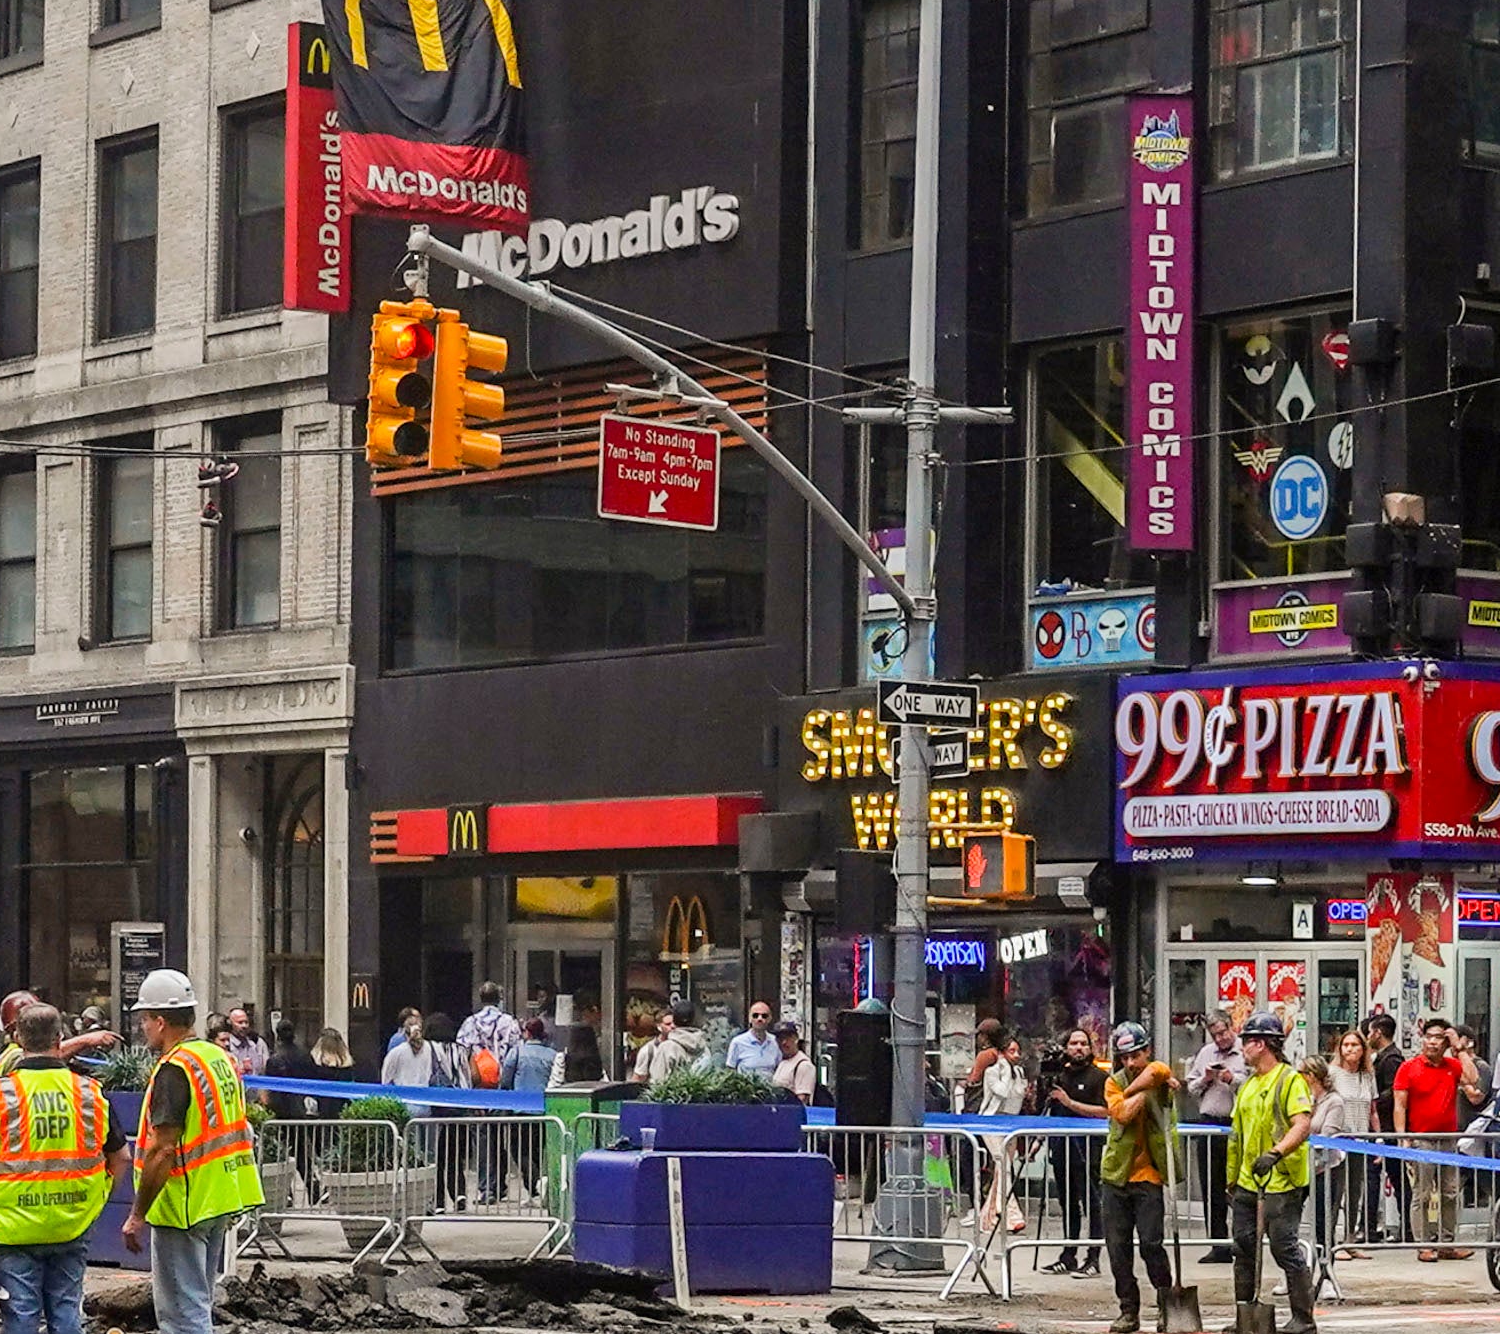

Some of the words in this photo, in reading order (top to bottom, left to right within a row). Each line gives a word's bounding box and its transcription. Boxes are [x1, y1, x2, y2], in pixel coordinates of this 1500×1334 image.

[316, 110, 342, 298] McDonald's
[367, 165, 528, 215] McDonald's
[456, 185, 740, 289] McDonald's
[1140, 182, 1184, 362] MIDTOWN
[625, 426, 641, 443] No
[645, 429, 696, 453] Standing
[607, 443, 656, 463] 7am-9am
[662, 451, 713, 471] 4pm-7pm
[1142, 382, 1182, 536] COMICS
[618, 464, 656, 485] Except
[660, 470, 701, 492] Sunday
[1252, 611, 1296, 629] MIDTOWN
[1299, 609, 1336, 625] COMICS
[893, 693, 922, 713] ONE
[935, 697, 965, 715] WAY
[801, 692, 1076, 783] SMOER'S
[1242, 692, 1409, 779] PIZZA
[934, 744, 958, 764] WAY
[851, 787, 1015, 849] WRLD
[1457, 823, 1474, 838] 7th
[1475, 825, 1500, 839] Ave.
[999, 929, 1048, 963] OPEN
[32, 1091, 69, 1114] NYC
[33, 1116, 69, 1140] DEP
[18, 1193, 41, 1207] FIELD
